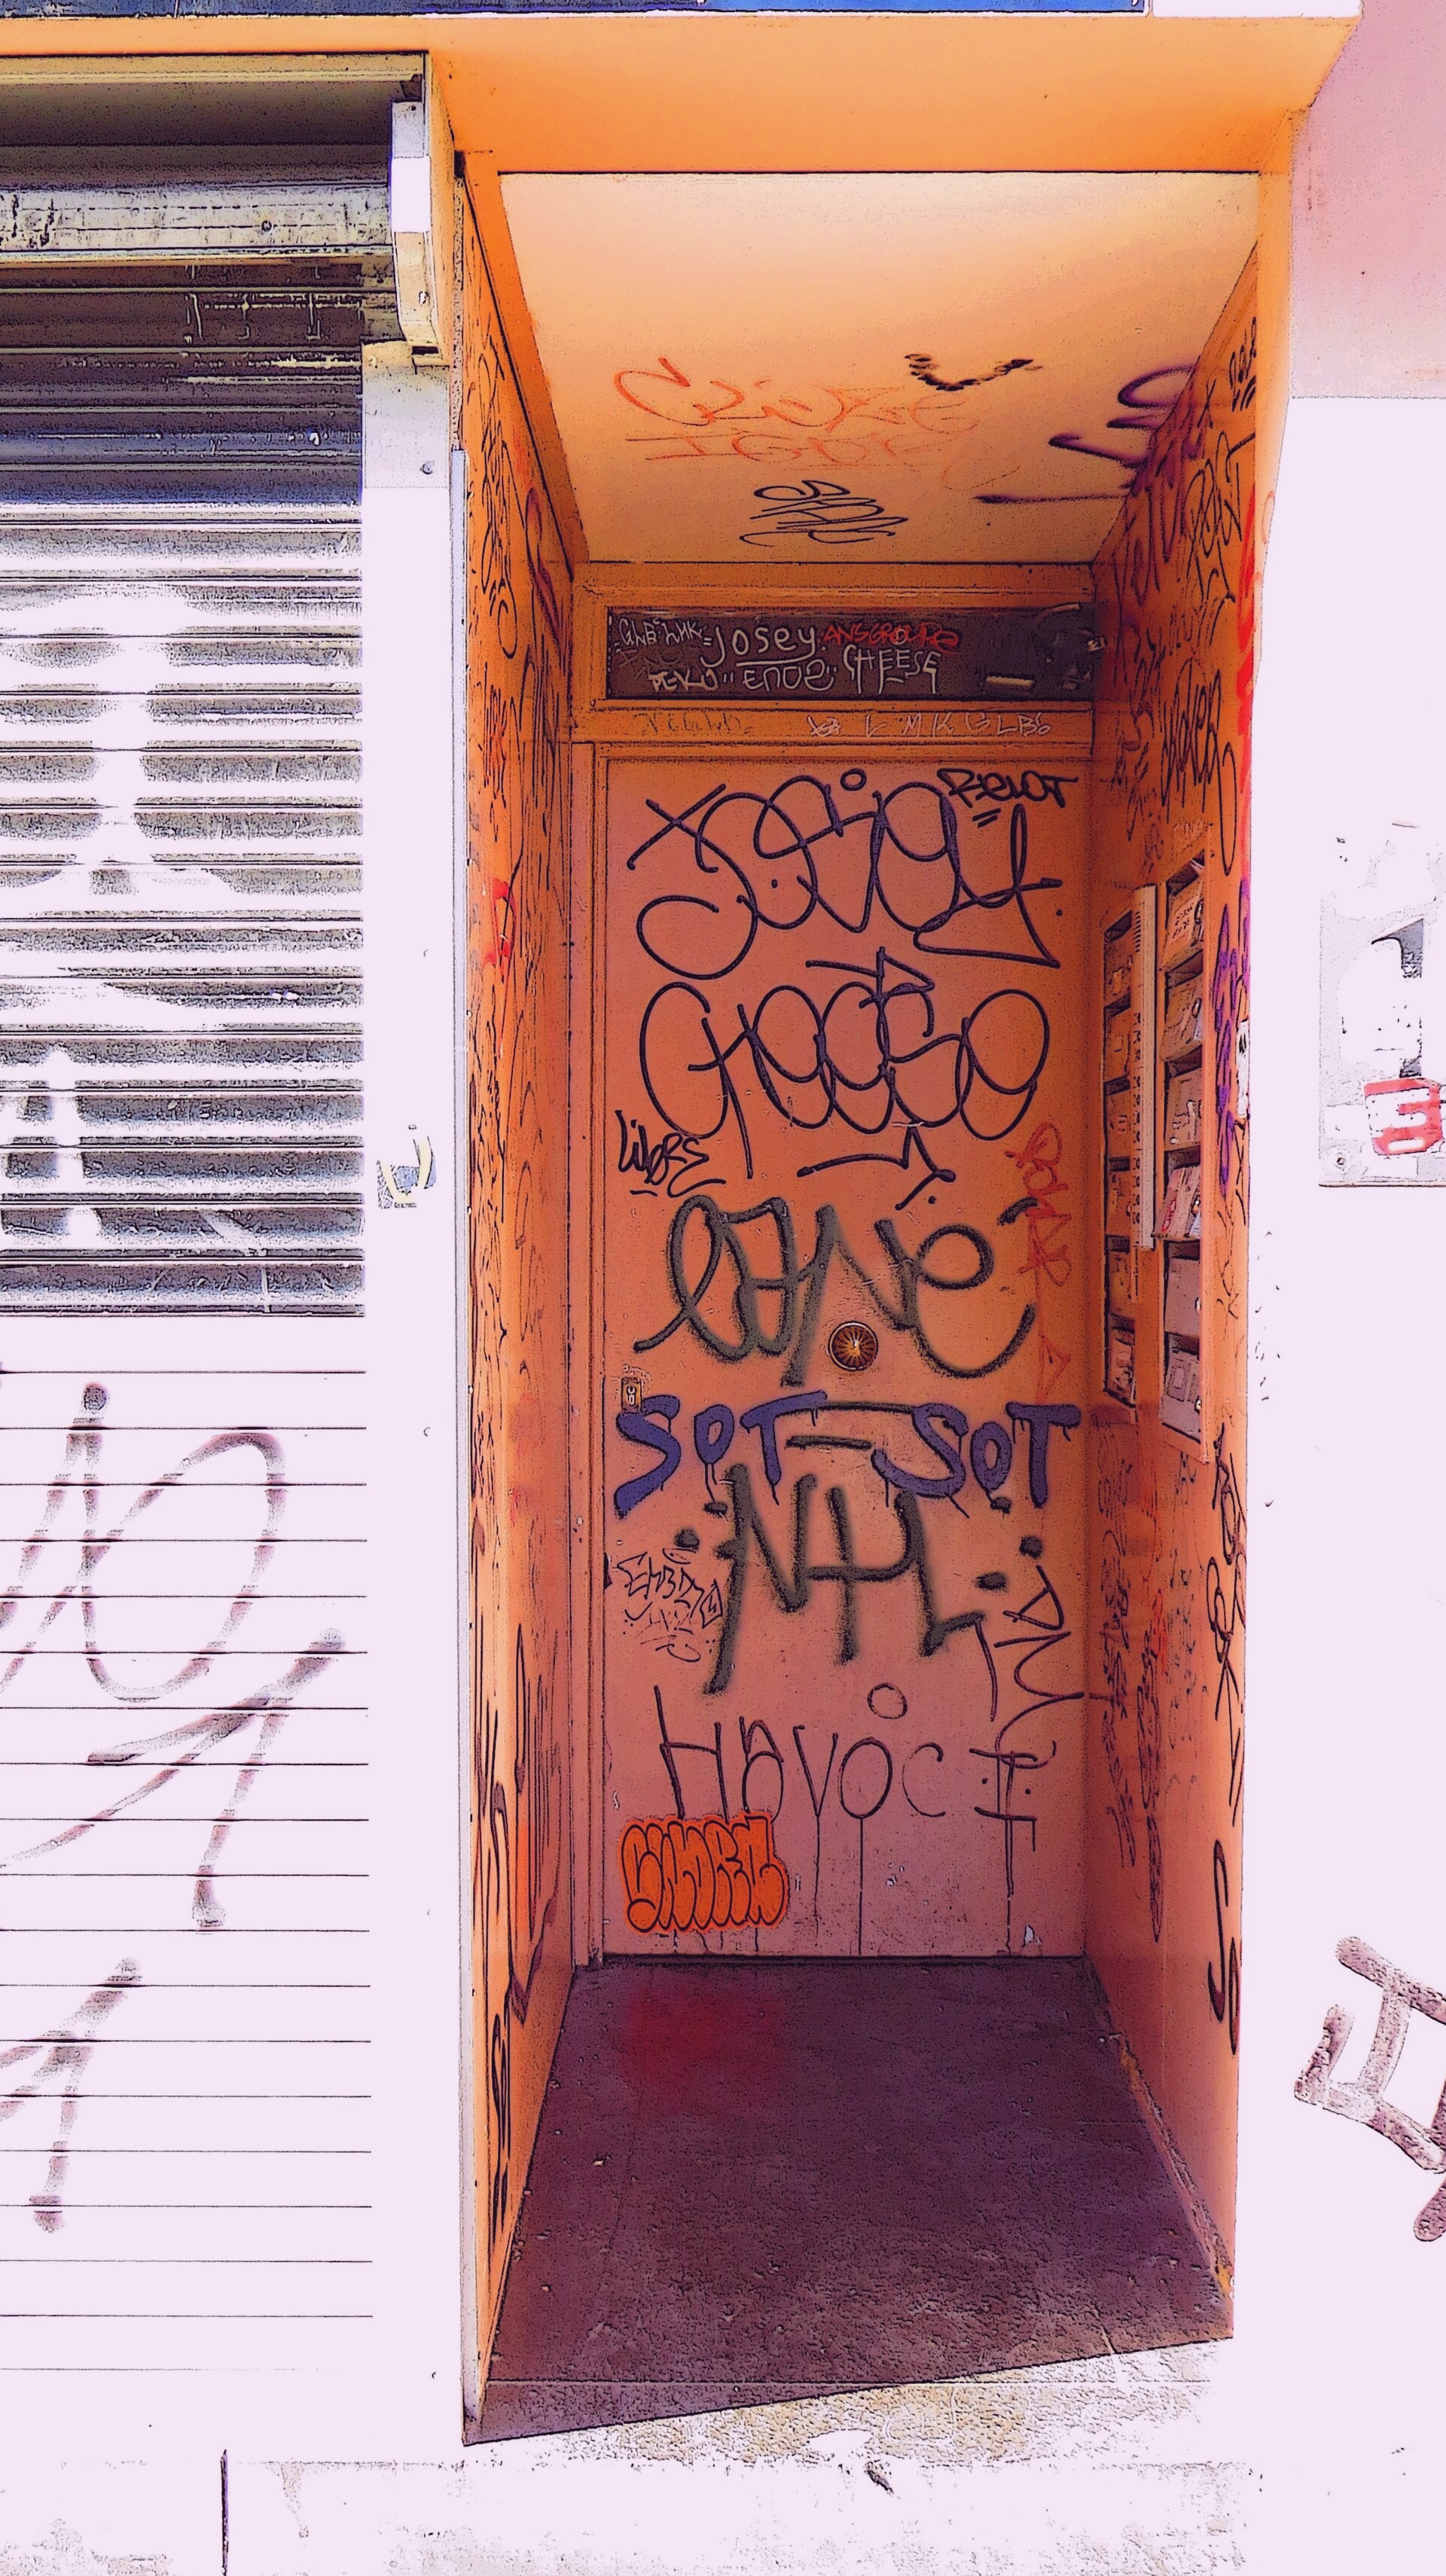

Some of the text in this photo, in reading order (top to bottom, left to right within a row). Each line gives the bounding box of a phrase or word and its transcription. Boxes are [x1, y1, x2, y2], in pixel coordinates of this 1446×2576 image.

[843, 643, 942, 694] CHEESE
[613, 1390, 1081, 1520] SOT SOT
